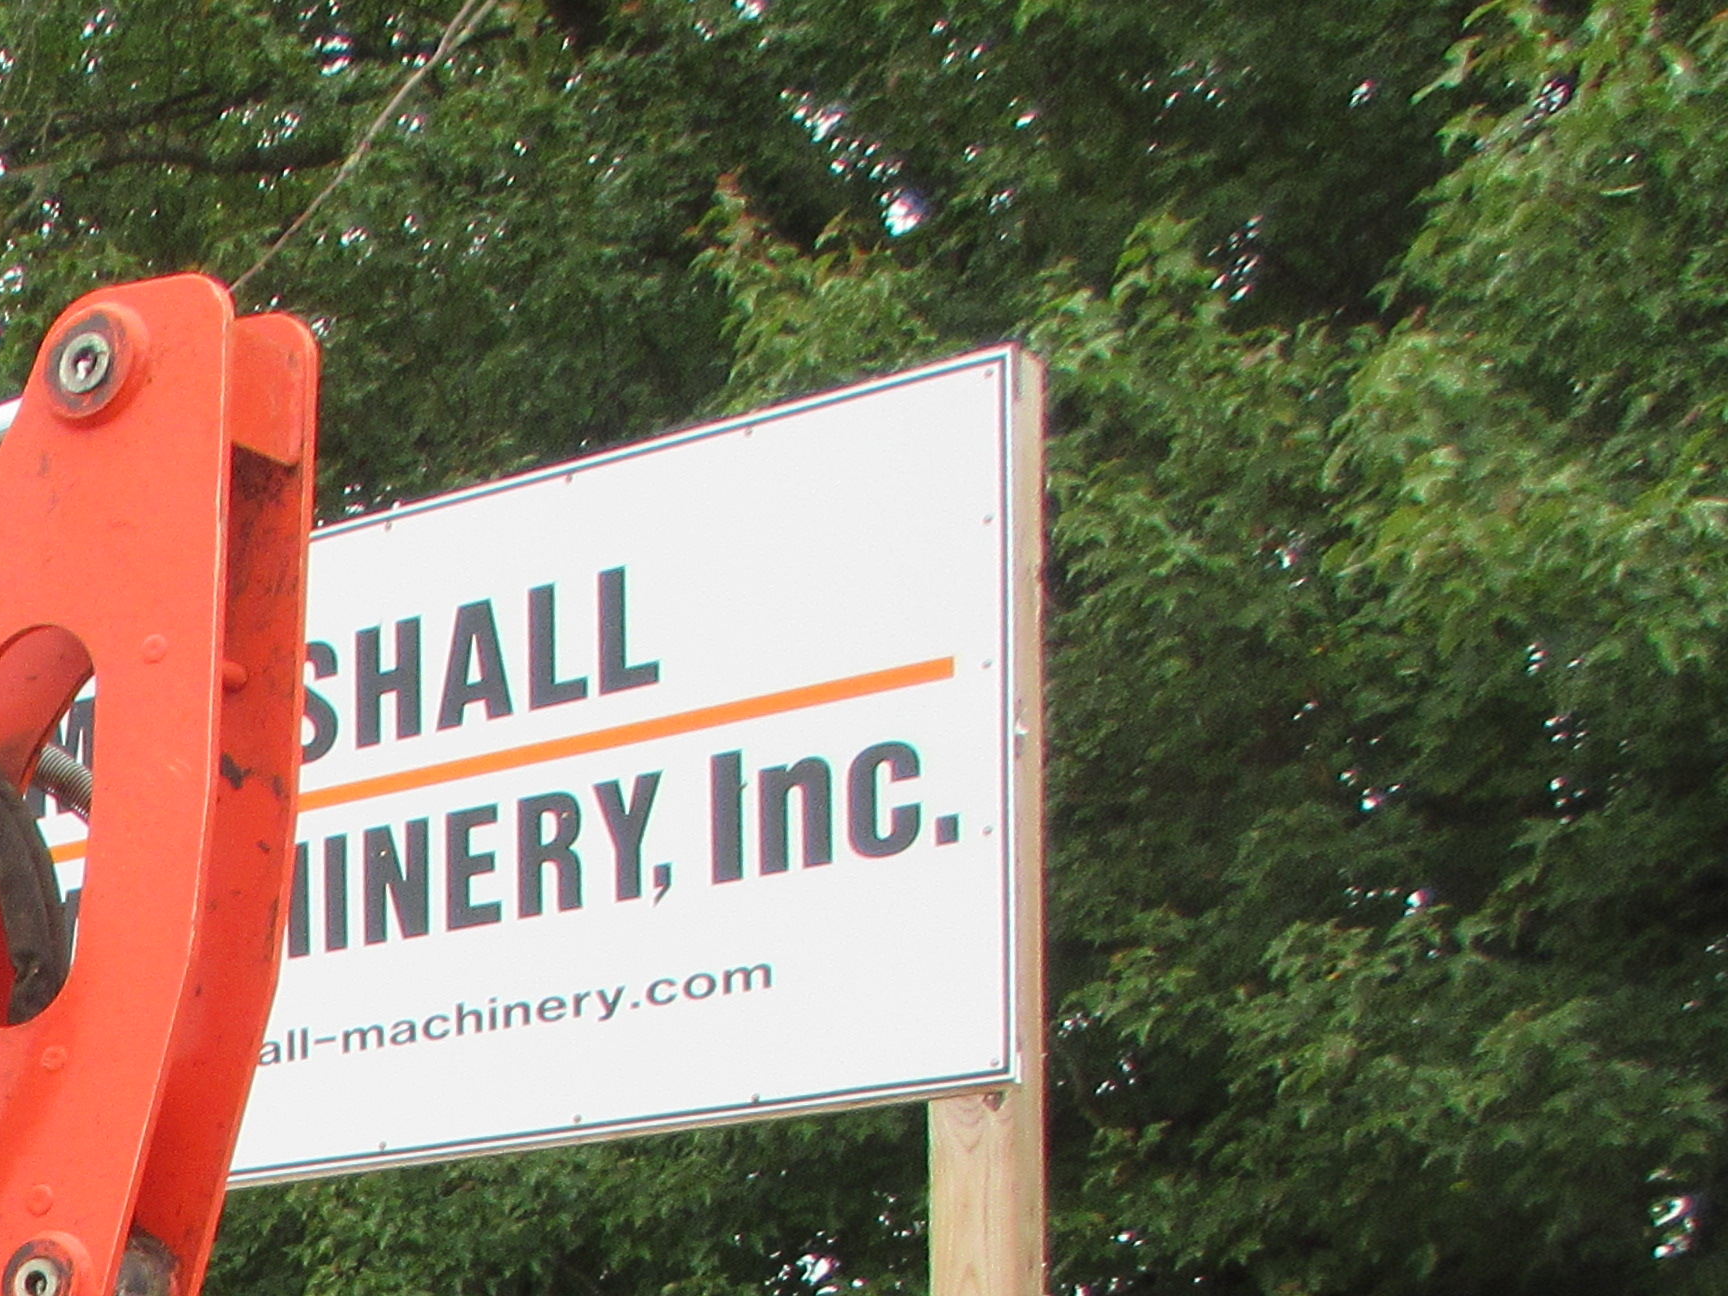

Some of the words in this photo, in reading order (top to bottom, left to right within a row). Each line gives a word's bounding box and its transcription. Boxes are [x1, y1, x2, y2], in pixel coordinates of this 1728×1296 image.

[300, 565, 662, 766] SHALL
[287, 768, 673, 961] INERY,
[710, 739, 961, 886] Inc.
[257, 962, 774, 1067] all-machinery.com
